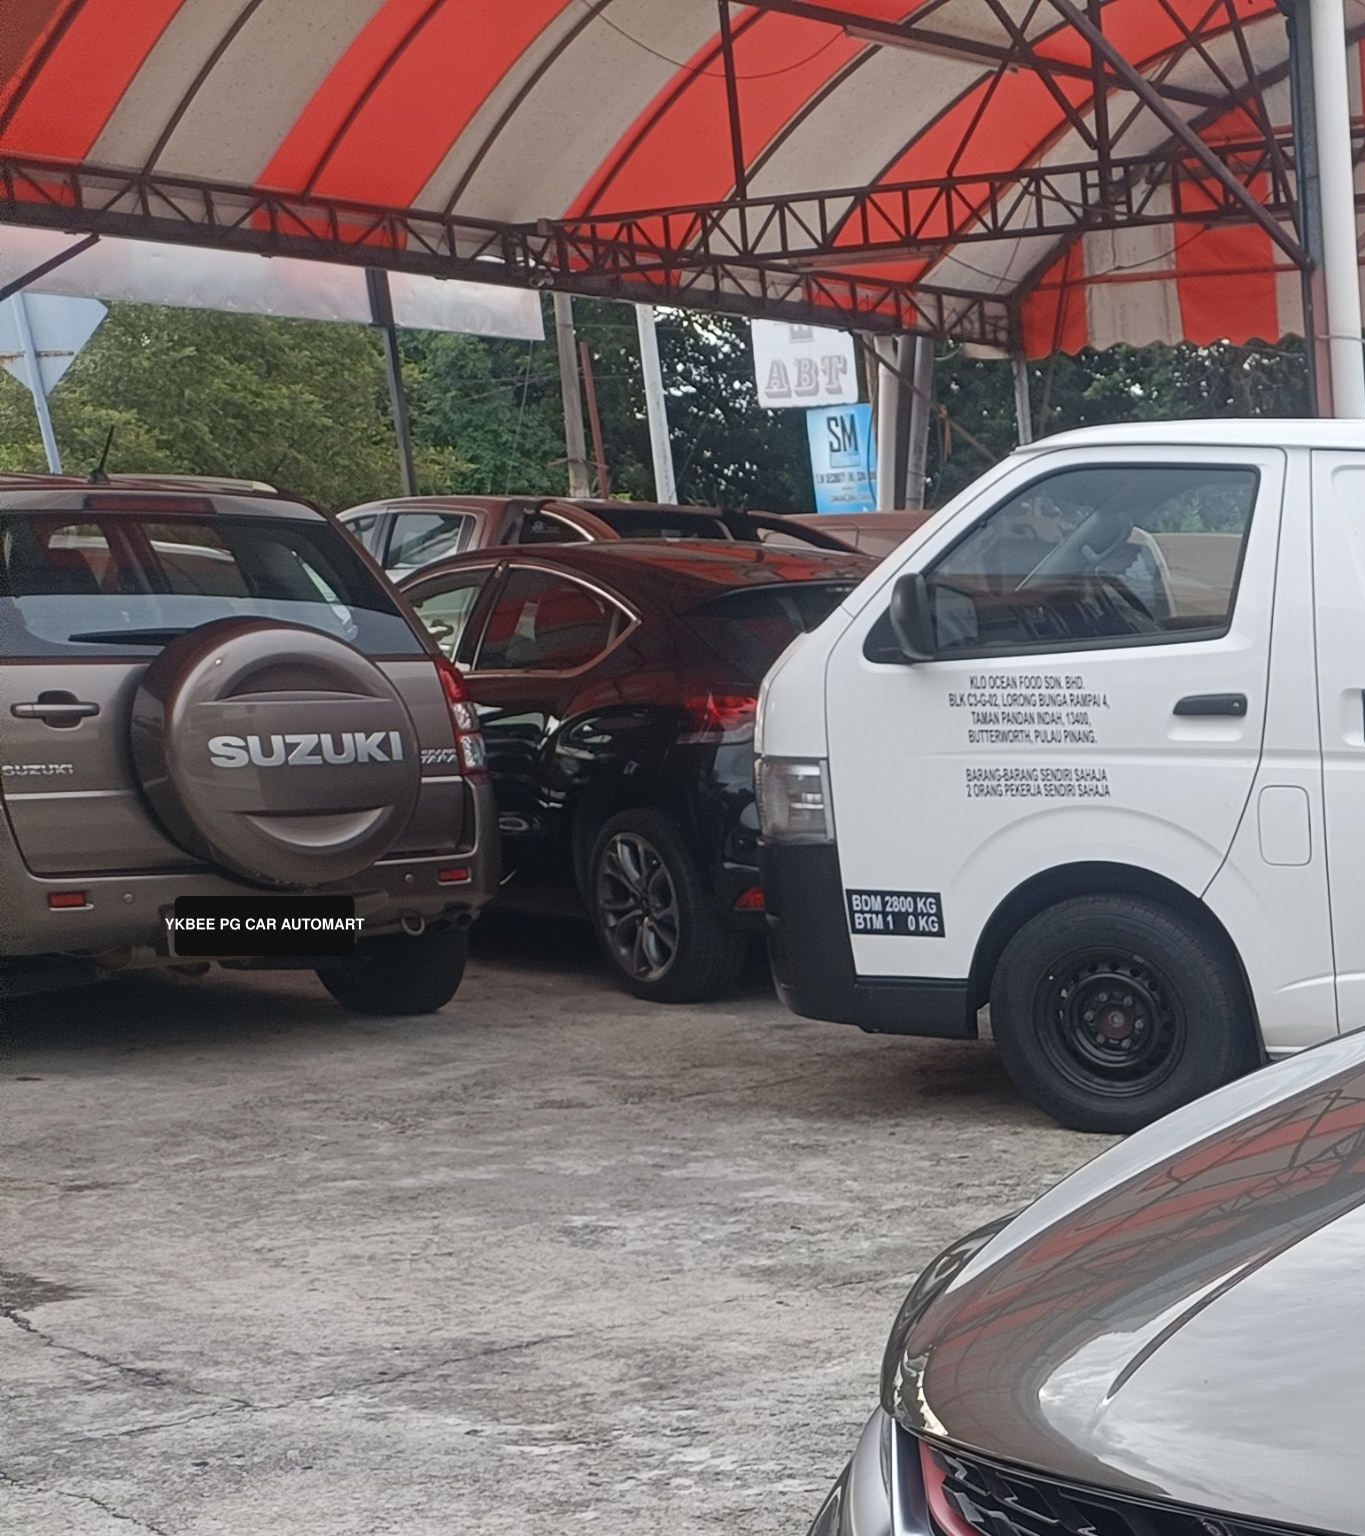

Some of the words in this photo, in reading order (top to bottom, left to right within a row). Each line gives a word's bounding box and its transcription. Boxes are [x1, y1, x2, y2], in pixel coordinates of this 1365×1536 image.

[764, 355, 847, 398] ABT
[826, 414, 859, 453] SM
[988, 675, 1018, 690] OCEAN
[1019, 675, 1043, 690] FOOD
[1044, 675, 1064, 690] SDN.
[1065, 675, 1086, 690] BHD.
[949, 693, 966, 707] BLK
[1001, 693, 1037, 708] LORONG
[1038, 693, 1069, 708] BUNGA
[1069, 693, 1101, 708] RAMPAI
[1102, 693, 1111, 710] 4,
[971, 711, 1000, 726] TAMAN
[1001, 711, 1035, 726] PANDAN
[1036, 711, 1066, 727] INDAH,
[1066, 711, 1092, 727] 13400,
[968, 729, 1034, 745] BUTTERWORTH,
[1034, 729, 1062, 744] PULAU
[1063, 729, 1098, 744] PINANG.
[207, 730, 404, 768] SUZUKI
[1, 763, 74, 776] SUZUKI
[965, 767, 1039, 783] BARANG-BARANG
[1040, 768, 1073, 783] SENDIRI
[1074, 768, 1109, 783] SAHAJA
[966, 783, 973, 798] 2
[973, 783, 1004, 798] ORANG
[1004, 783, 1043, 798] PEKERJA
[1043, 783, 1076, 798] SENDIRI
[1077, 783, 1111, 798] SAHAJA
[851, 894, 883, 912] BDM
[884, 896, 914, 913] 2800
[916, 896, 937, 914] KG
[854, 912, 884, 930] BTM
[886, 913, 894, 930] 1
[918, 915, 940, 932] KG
